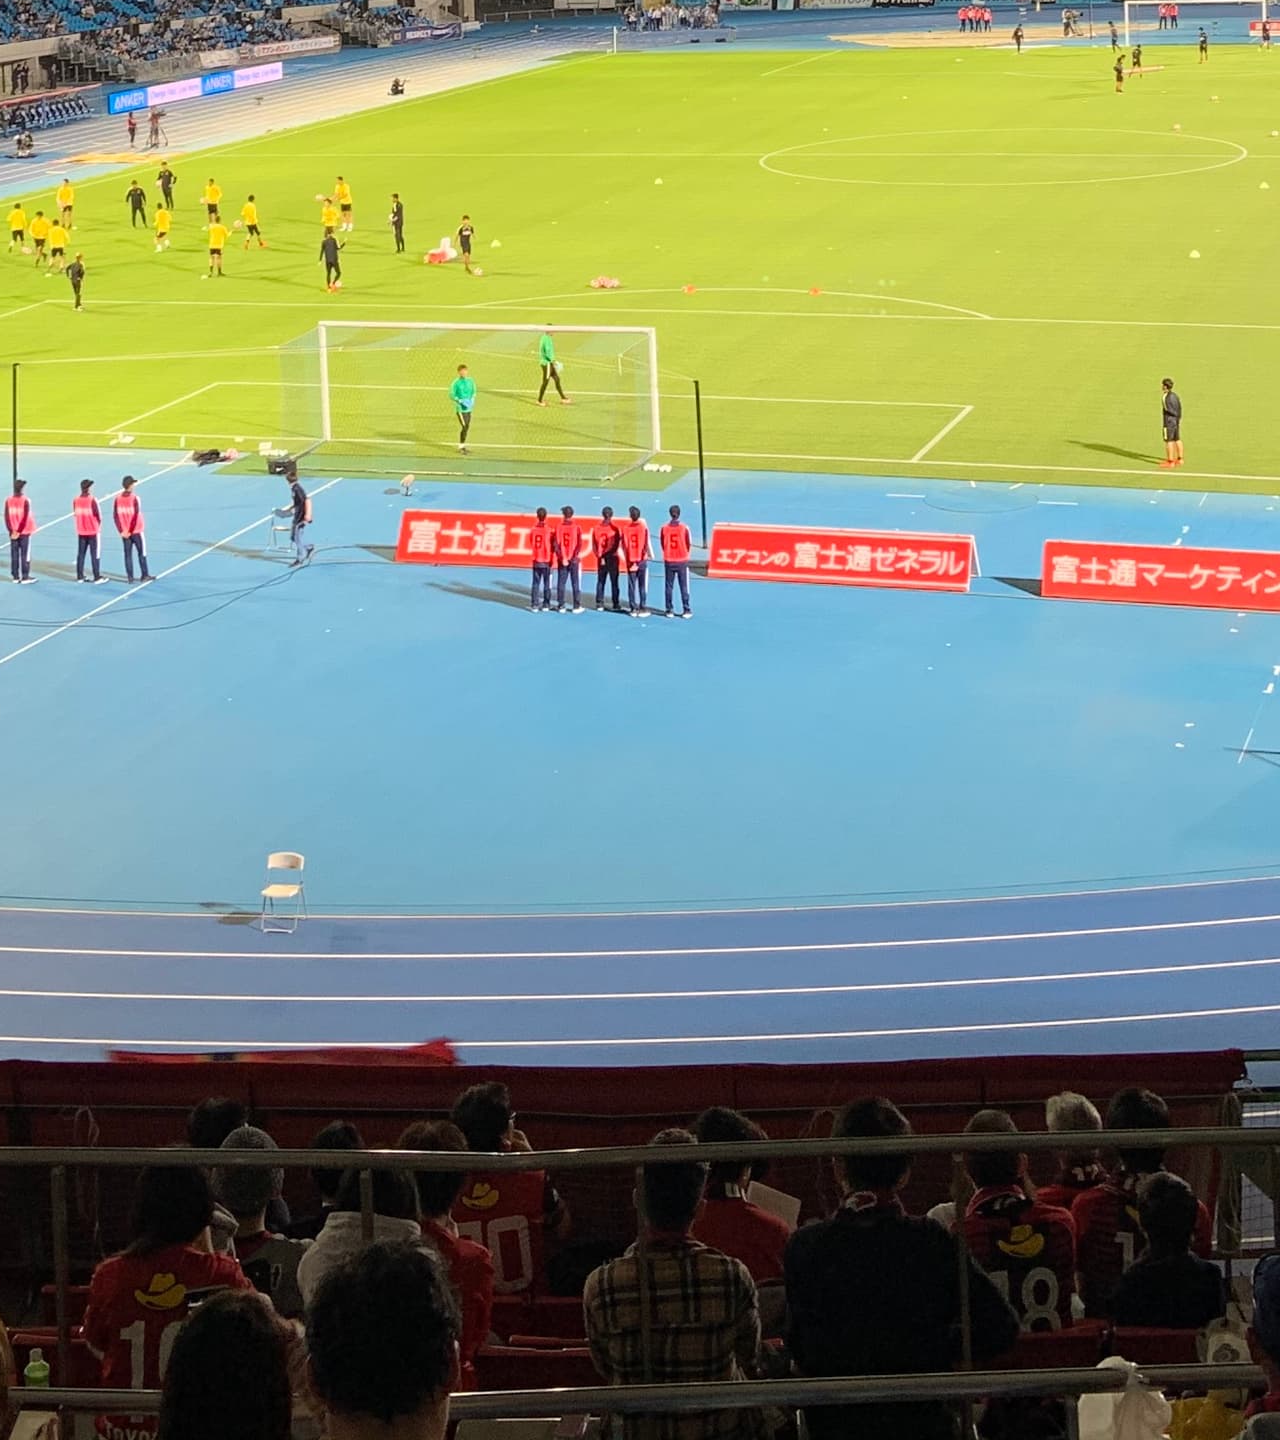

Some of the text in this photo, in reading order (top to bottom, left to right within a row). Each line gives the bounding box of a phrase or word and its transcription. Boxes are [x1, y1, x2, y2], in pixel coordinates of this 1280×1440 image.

[114, 93, 145, 109] ANKER
[717, 541, 966, 576] エアコンの 富士通ゼネラル
